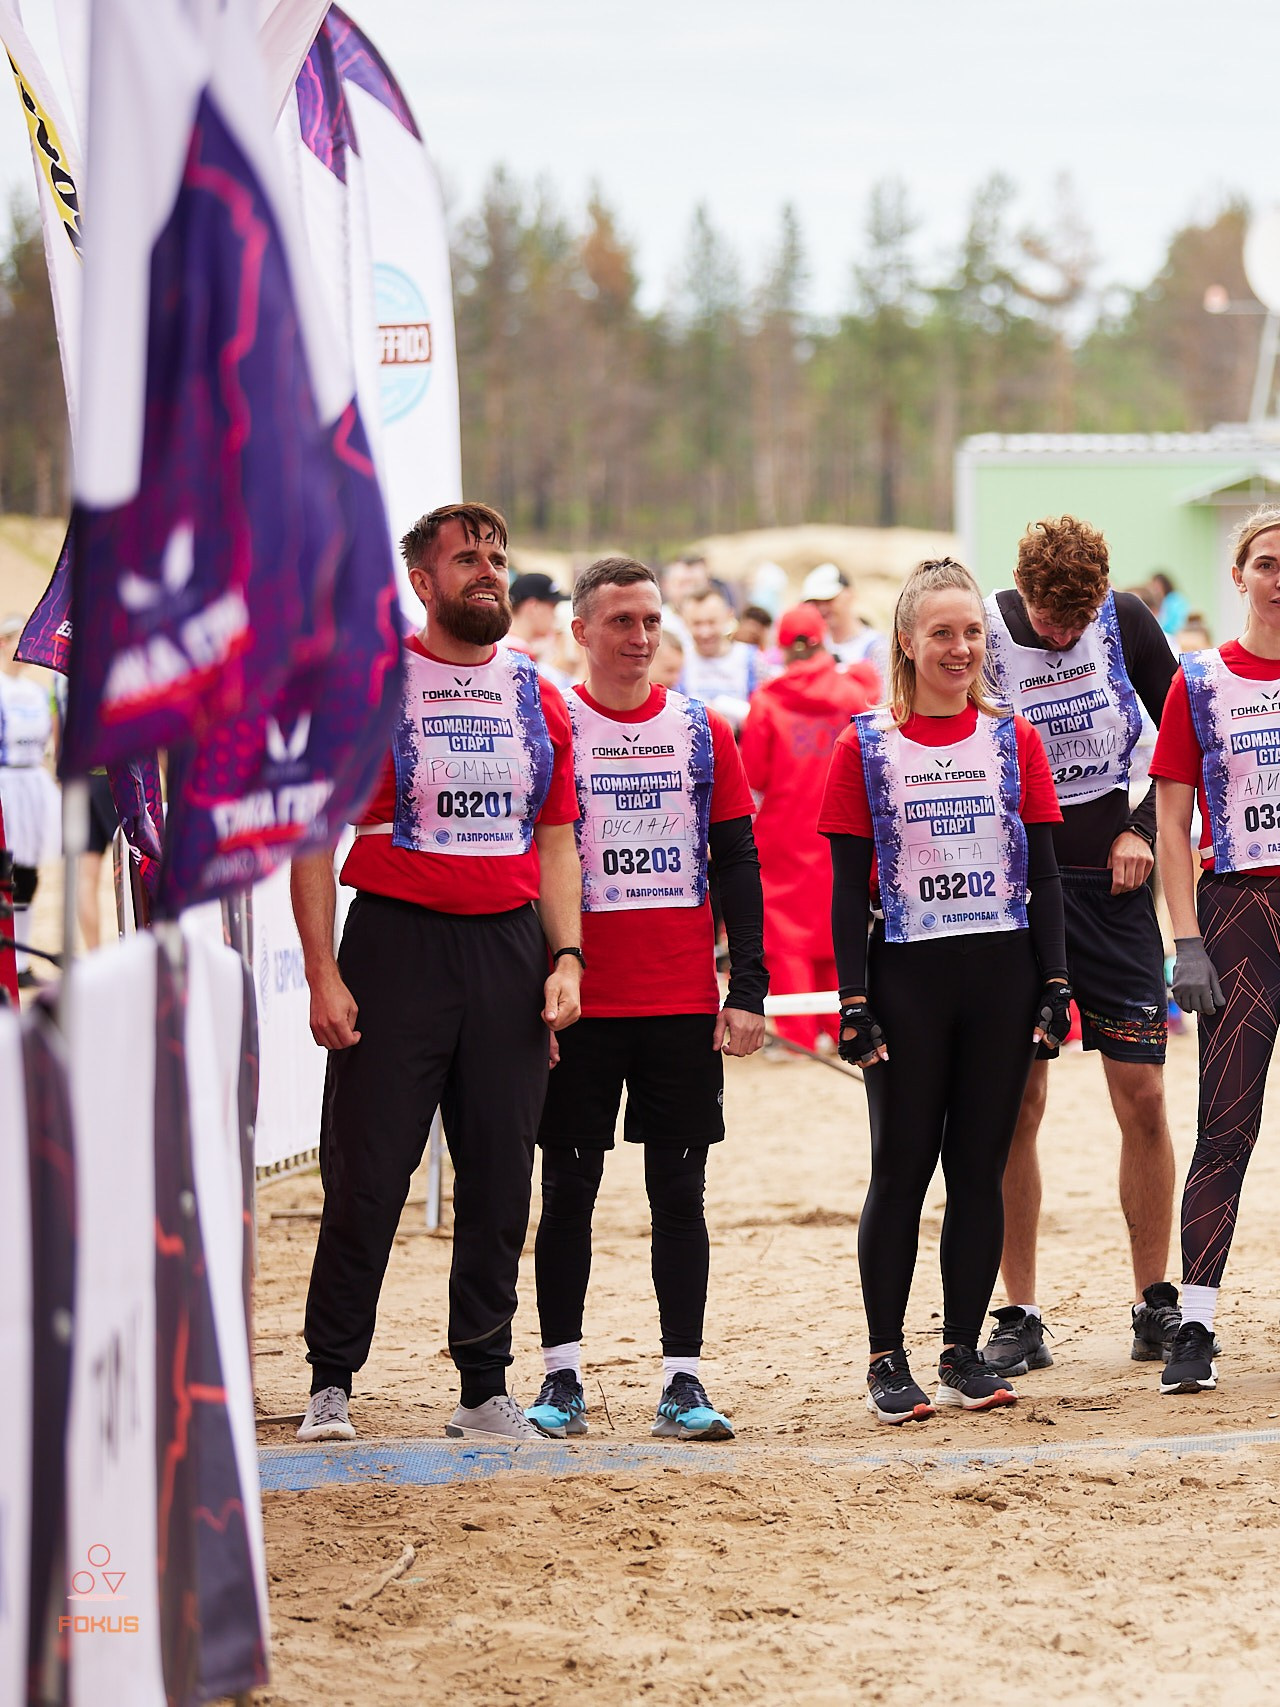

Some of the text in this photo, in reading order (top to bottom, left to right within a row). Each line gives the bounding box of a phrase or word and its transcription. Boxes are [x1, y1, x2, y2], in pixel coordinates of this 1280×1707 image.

[1019, 662, 1096, 690] ГОНКА ГЕРОЕВ
[422, 690, 502, 701] ГОНКА ГЕРОЕВ
[1024, 689, 1107, 722] КОМАНДНЫЙ
[1231, 704, 1268, 717] ГОНКА
[424, 718, 512, 736] КОМАНДНЫЙ
[1050, 714, 1090, 734] СТАРТ
[451, 735, 491, 751] СТАРТ
[592, 745, 674, 756] ГОНКА ГЕРОЕВ
[430, 759, 512, 784] РОМАН
[904, 770, 986, 784] ГОНКА ГЕРОЕВ
[592, 771, 681, 792] КОМАНДНЫЙ
[437, 791, 512, 818] 03201
[618, 792, 658, 809] СТАРТ
[906, 796, 994, 819] КОМАНДНЫЙ
[602, 815, 679, 840] РУСЛАН
[932, 818, 972, 834] СТАРТ
[456, 832, 514, 842] ГАЗПРОМБАНК
[603, 846, 681, 875] 03203
[918, 842, 982, 865] ОЛЬГА
[626, 887, 684, 898] ГАЗПРОМБАНК
[919, 871, 996, 902] 03202
[942, 911, 999, 924] ГАЗПРОМБАНК
